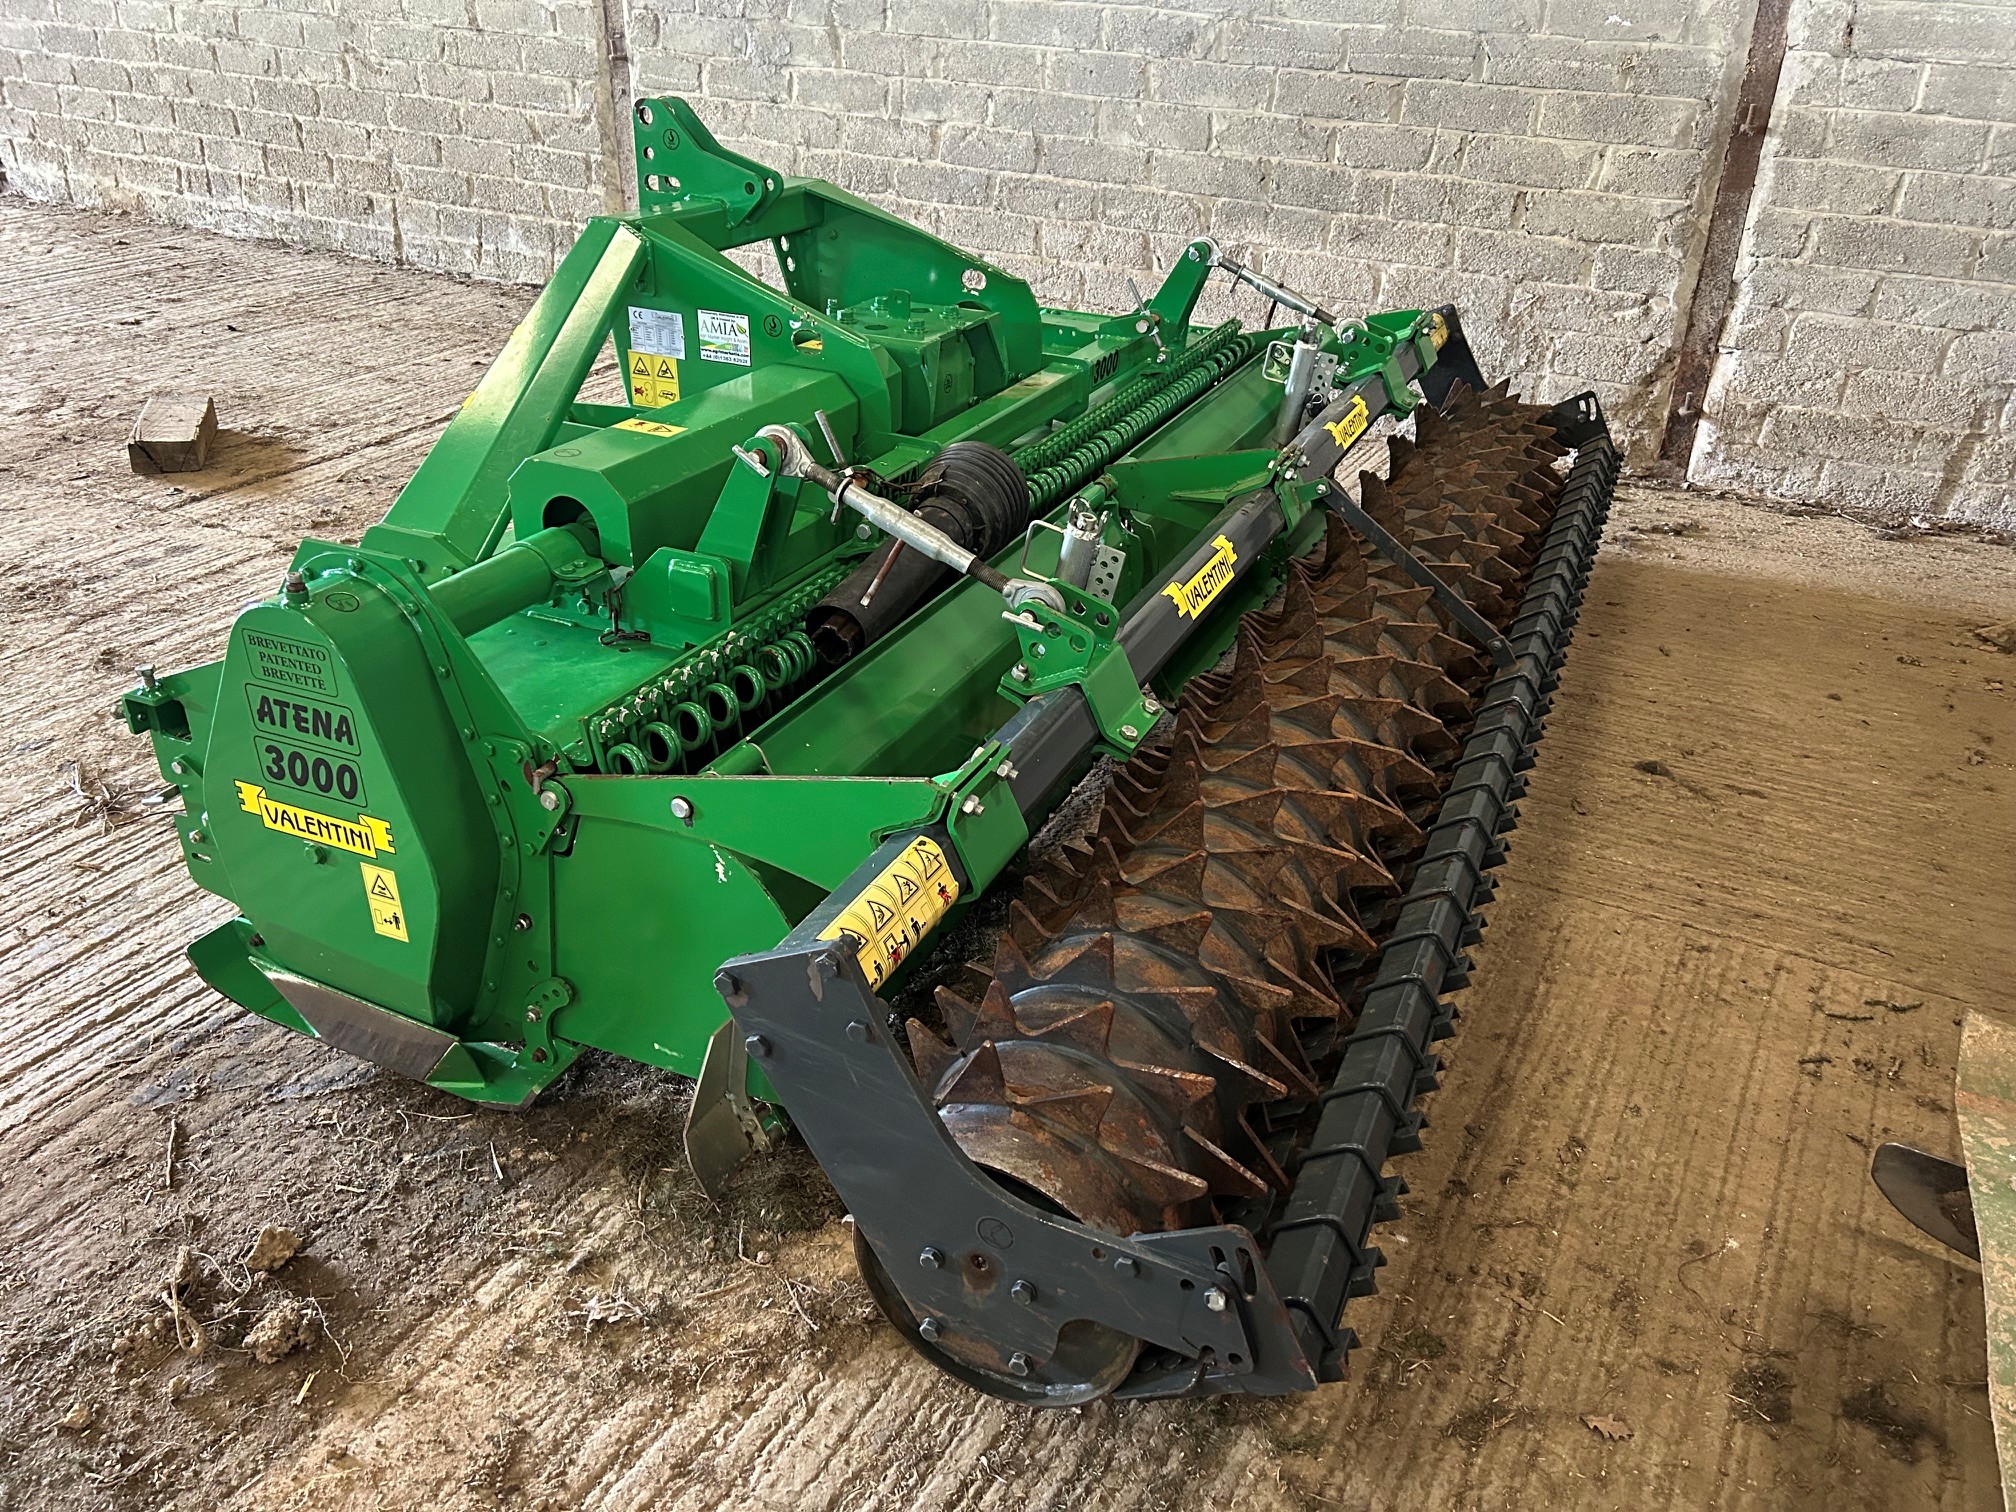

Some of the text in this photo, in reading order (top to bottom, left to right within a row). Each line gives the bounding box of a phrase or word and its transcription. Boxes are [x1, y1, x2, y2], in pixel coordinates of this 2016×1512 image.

[700, 319, 738, 337] AMIA
[1093, 348, 1119, 384] 3000
[1338, 408, 1366, 444] VALENTINI
[1186, 554, 1232, 610] VALENTINI
[247, 634, 326, 662] BREVETTATO
[258, 651, 322, 675] PATENTED
[256, 694, 354, 746] ATENA
[264, 743, 358, 800] 3000
[264, 804, 372, 851] VALENTINI
